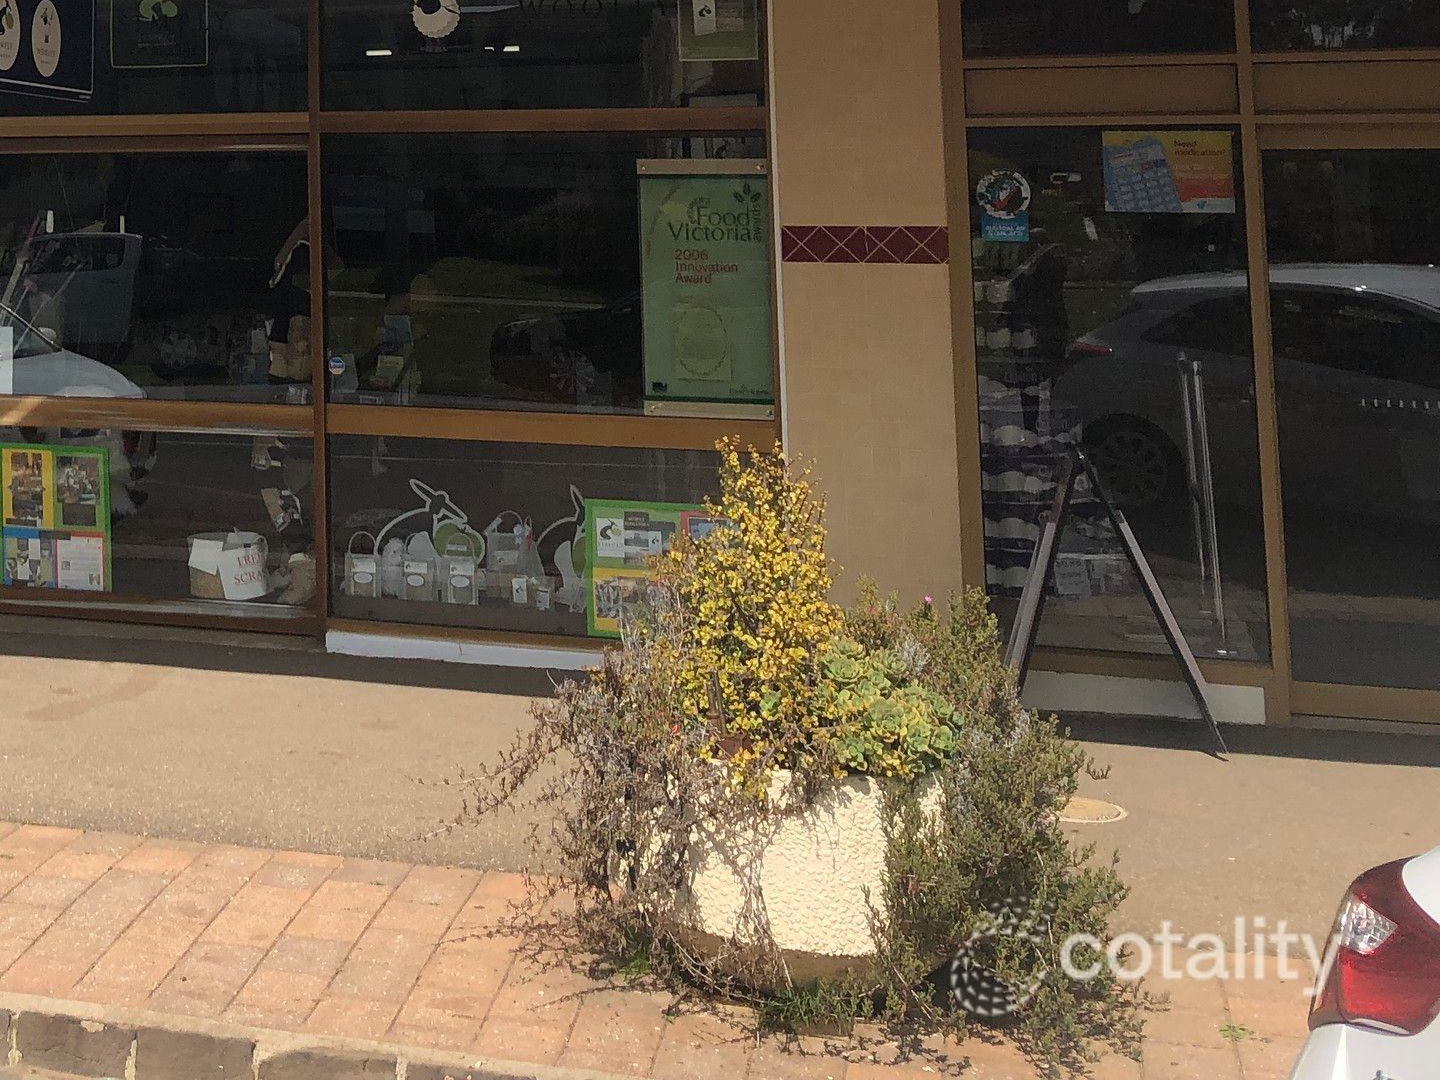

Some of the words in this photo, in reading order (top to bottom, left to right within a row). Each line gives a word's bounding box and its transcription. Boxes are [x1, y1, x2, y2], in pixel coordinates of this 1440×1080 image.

[696, 203, 750, 226] Food
[667, 220, 752, 242] Victoria
[674, 248, 709, 261] 2006
[675, 261, 738, 273] Innovation
[675, 273, 712, 284] Award
